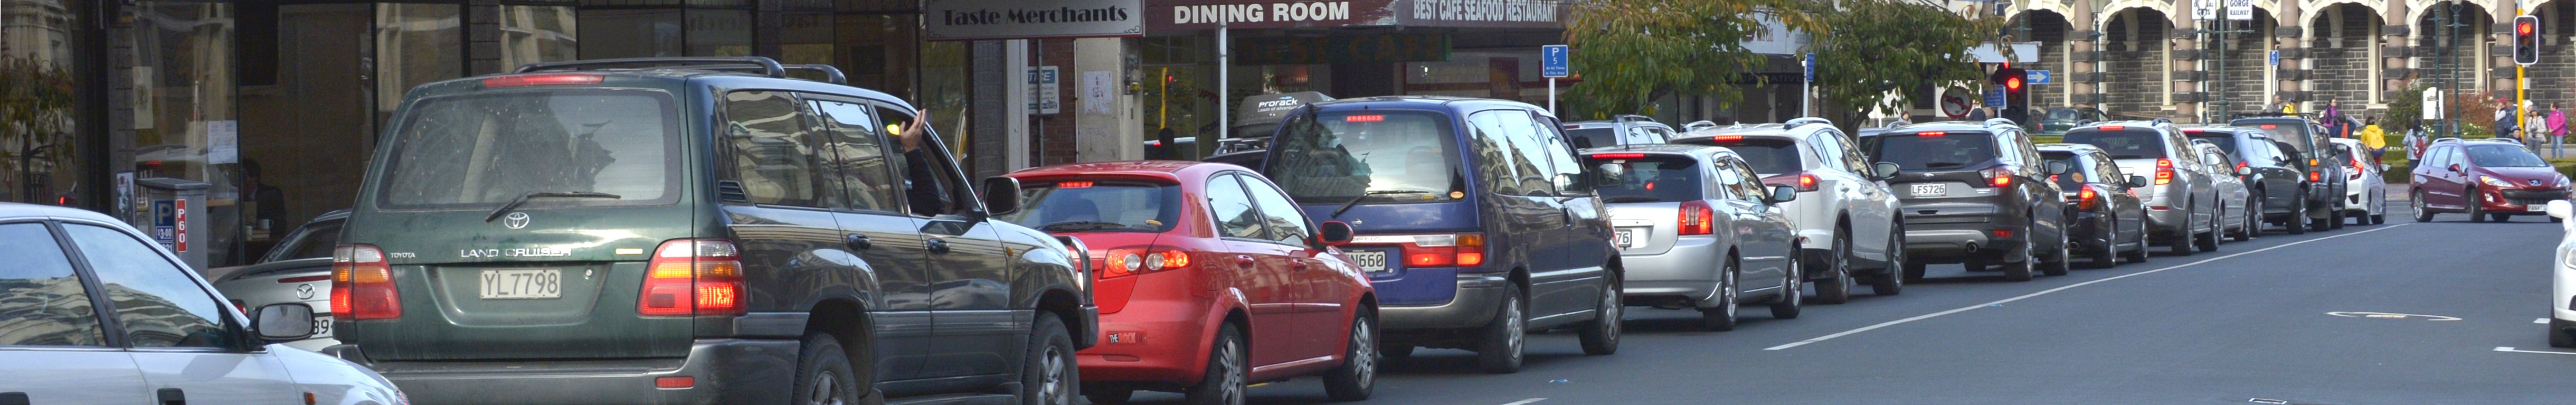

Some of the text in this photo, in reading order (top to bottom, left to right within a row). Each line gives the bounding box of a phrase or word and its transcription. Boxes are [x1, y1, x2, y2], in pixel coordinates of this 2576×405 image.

[942, 5, 1128, 26] Taste Merchants
[1175, 2, 1349, 24] DINING ROOM
[1414, 0, 1557, 22] BEST CAFE SEAFOOD RESTAURANT
[1552, 48, 1559, 56] P
[1258, 98, 1298, 108] prorack
[1912, 185, 1945, 194] LFS726
[461, 248, 572, 258] LAND CRUISER
[484, 272, 558, 296] YL7798
[1109, 333, 1119, 344] THE
[1119, 332, 1136, 344] ROCK
